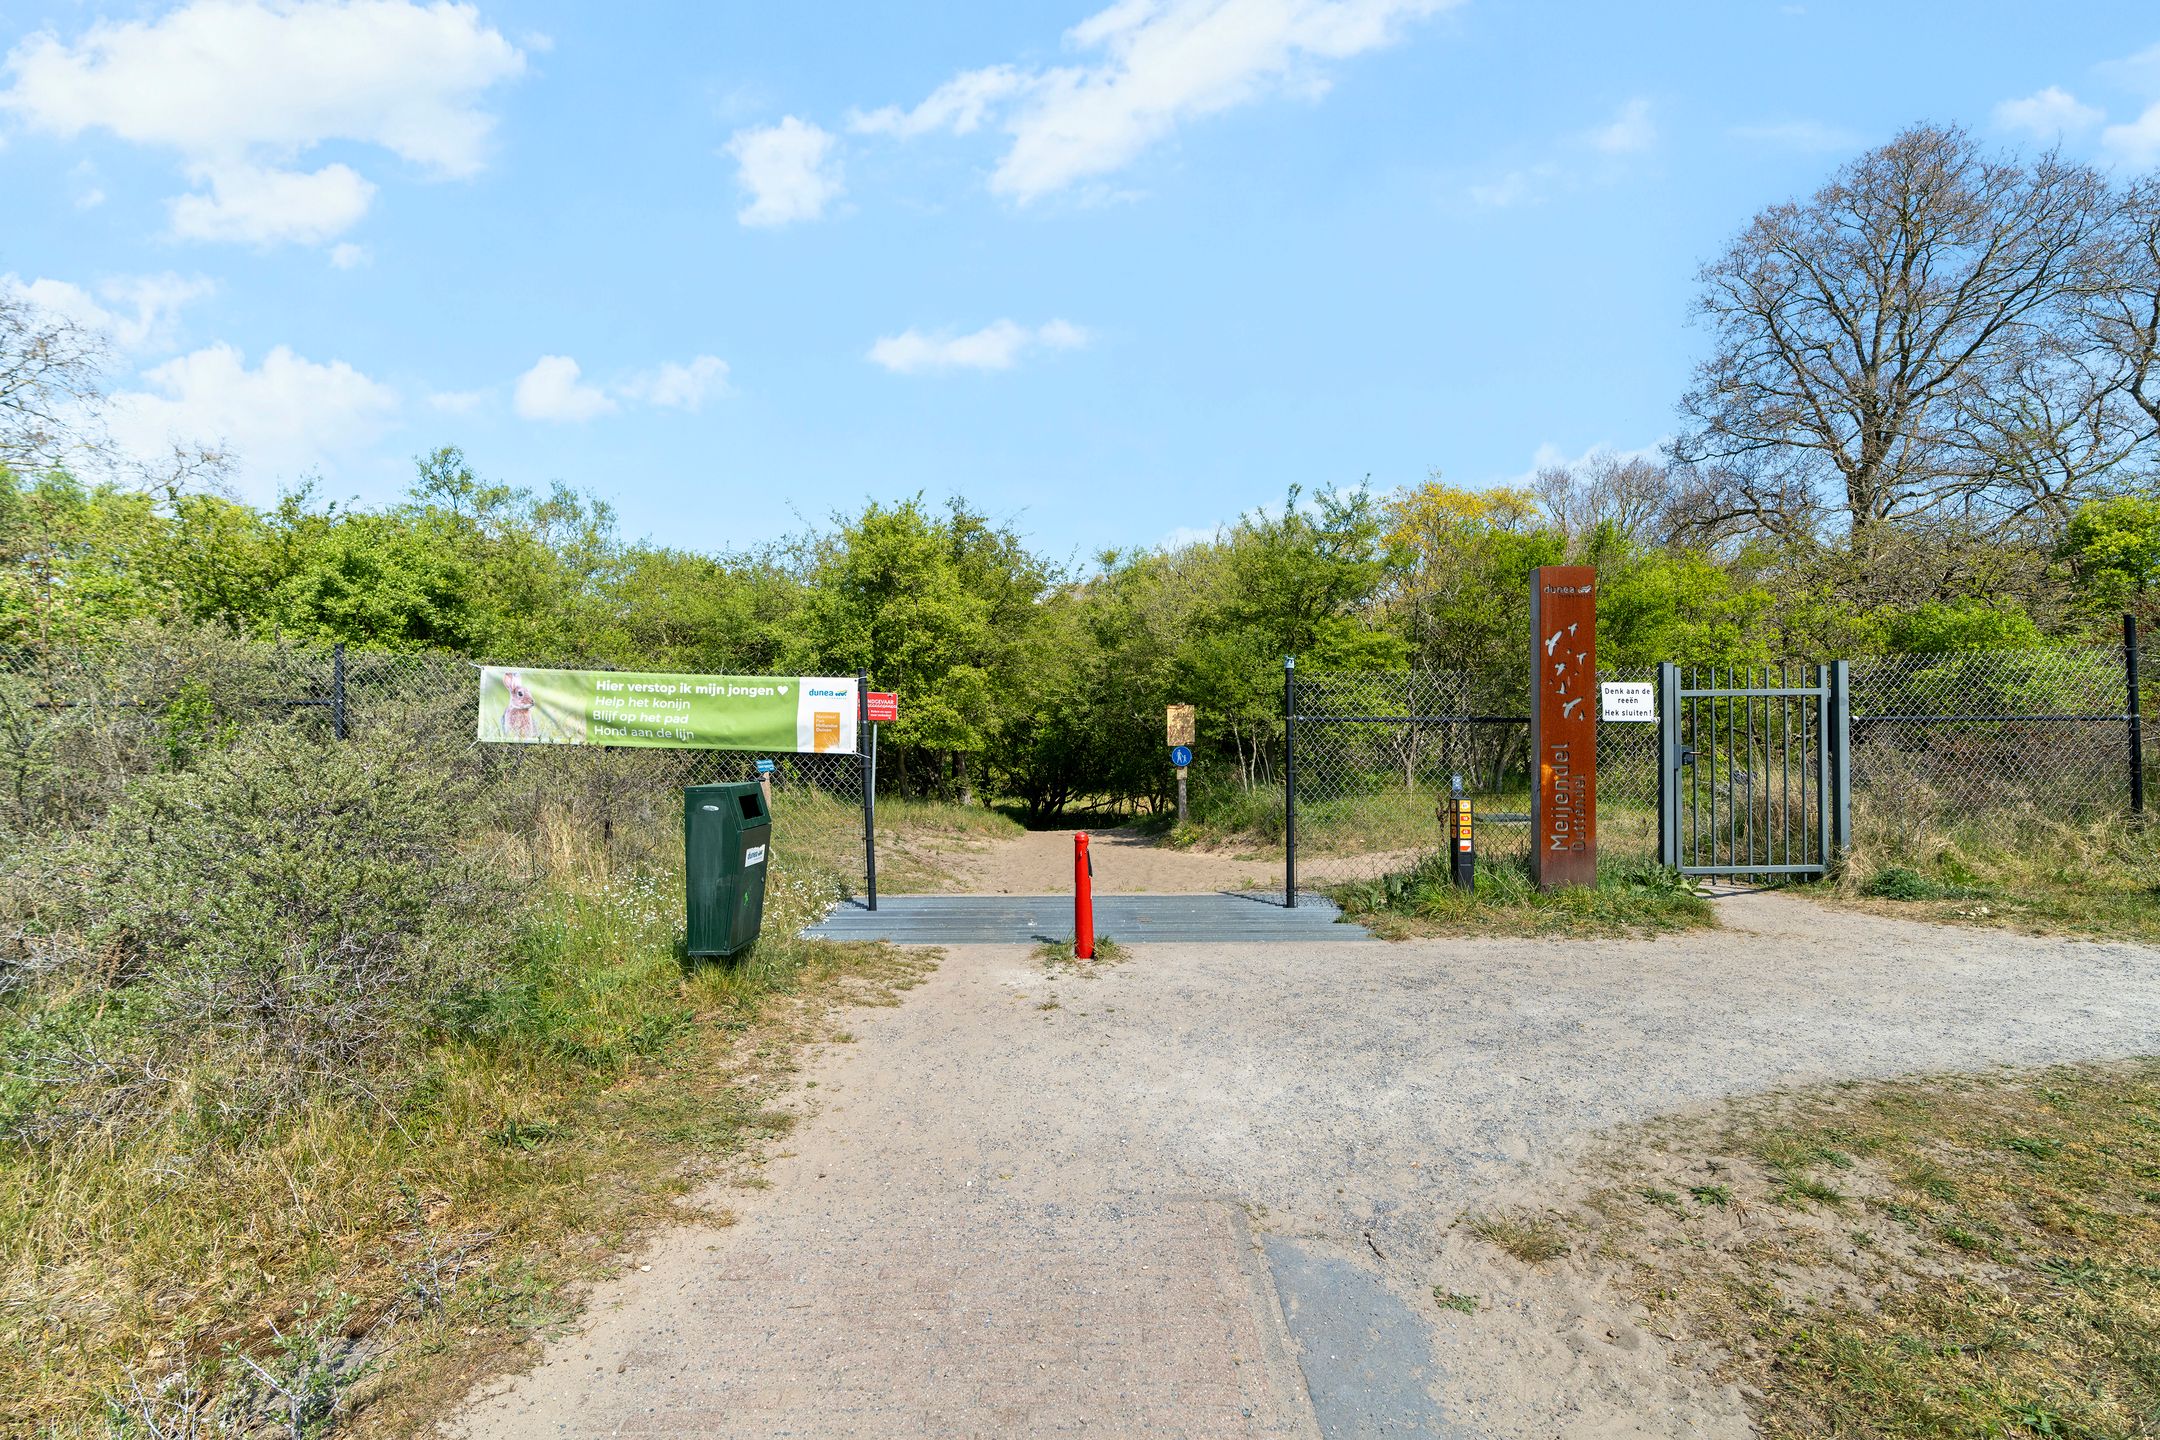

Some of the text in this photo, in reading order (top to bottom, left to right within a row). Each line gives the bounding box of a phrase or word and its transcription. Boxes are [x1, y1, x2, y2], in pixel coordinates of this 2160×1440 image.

[1543, 584, 1576, 594] dunea
[596, 680, 774, 698] Hier verstop ik mijn jongen
[808, 688, 834, 697] dunea
[1604, 687, 1624, 695] Denk
[594, 695, 690, 711] Help het konijn
[1617, 696, 1639, 704] reeën
[593, 710, 689, 725] Blijf op het pad
[1604, 709, 1620, 717] Hek
[594, 725, 694, 741] Hond aan de lijn
[1550, 742, 1575, 851] Meijendel
